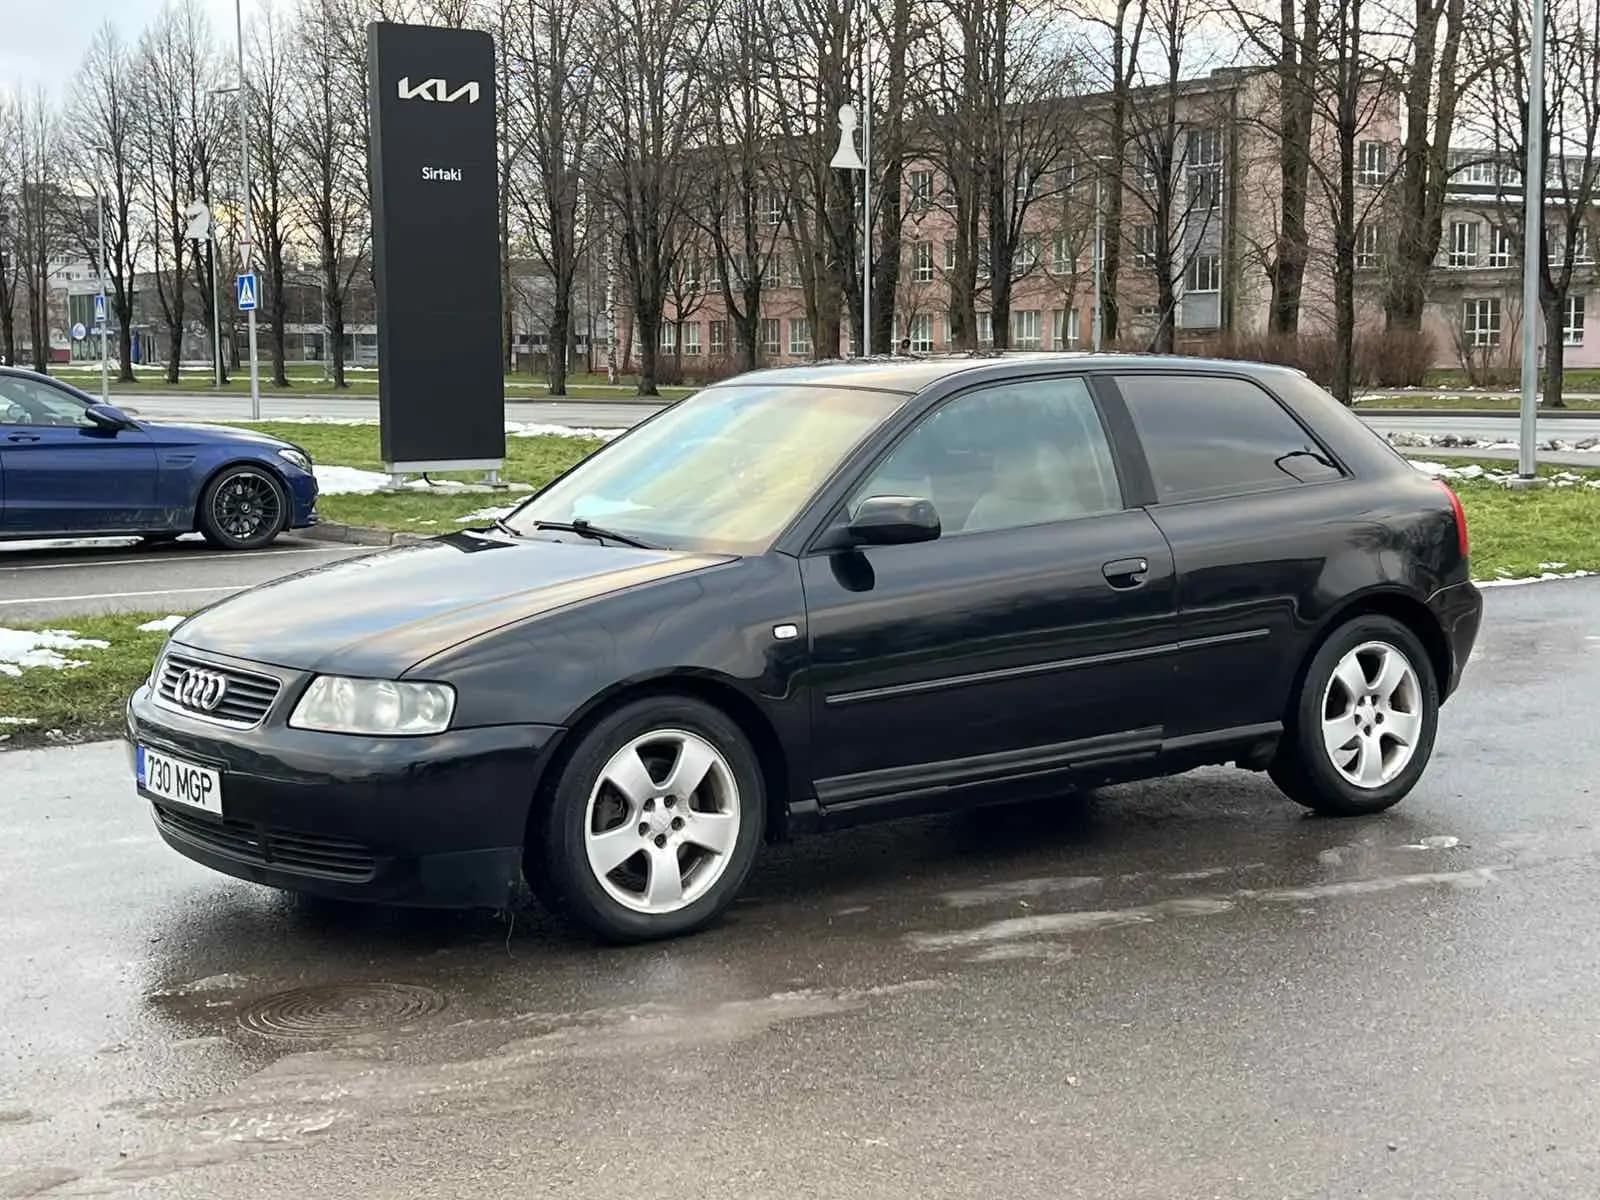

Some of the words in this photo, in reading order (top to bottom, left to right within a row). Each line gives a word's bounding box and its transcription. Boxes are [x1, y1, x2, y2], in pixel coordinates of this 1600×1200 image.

[398, 76, 480, 104] KIA
[421, 166, 462, 181] Sirtaki
[148, 754, 171, 793] 730
[176, 764, 212, 805] MGP
